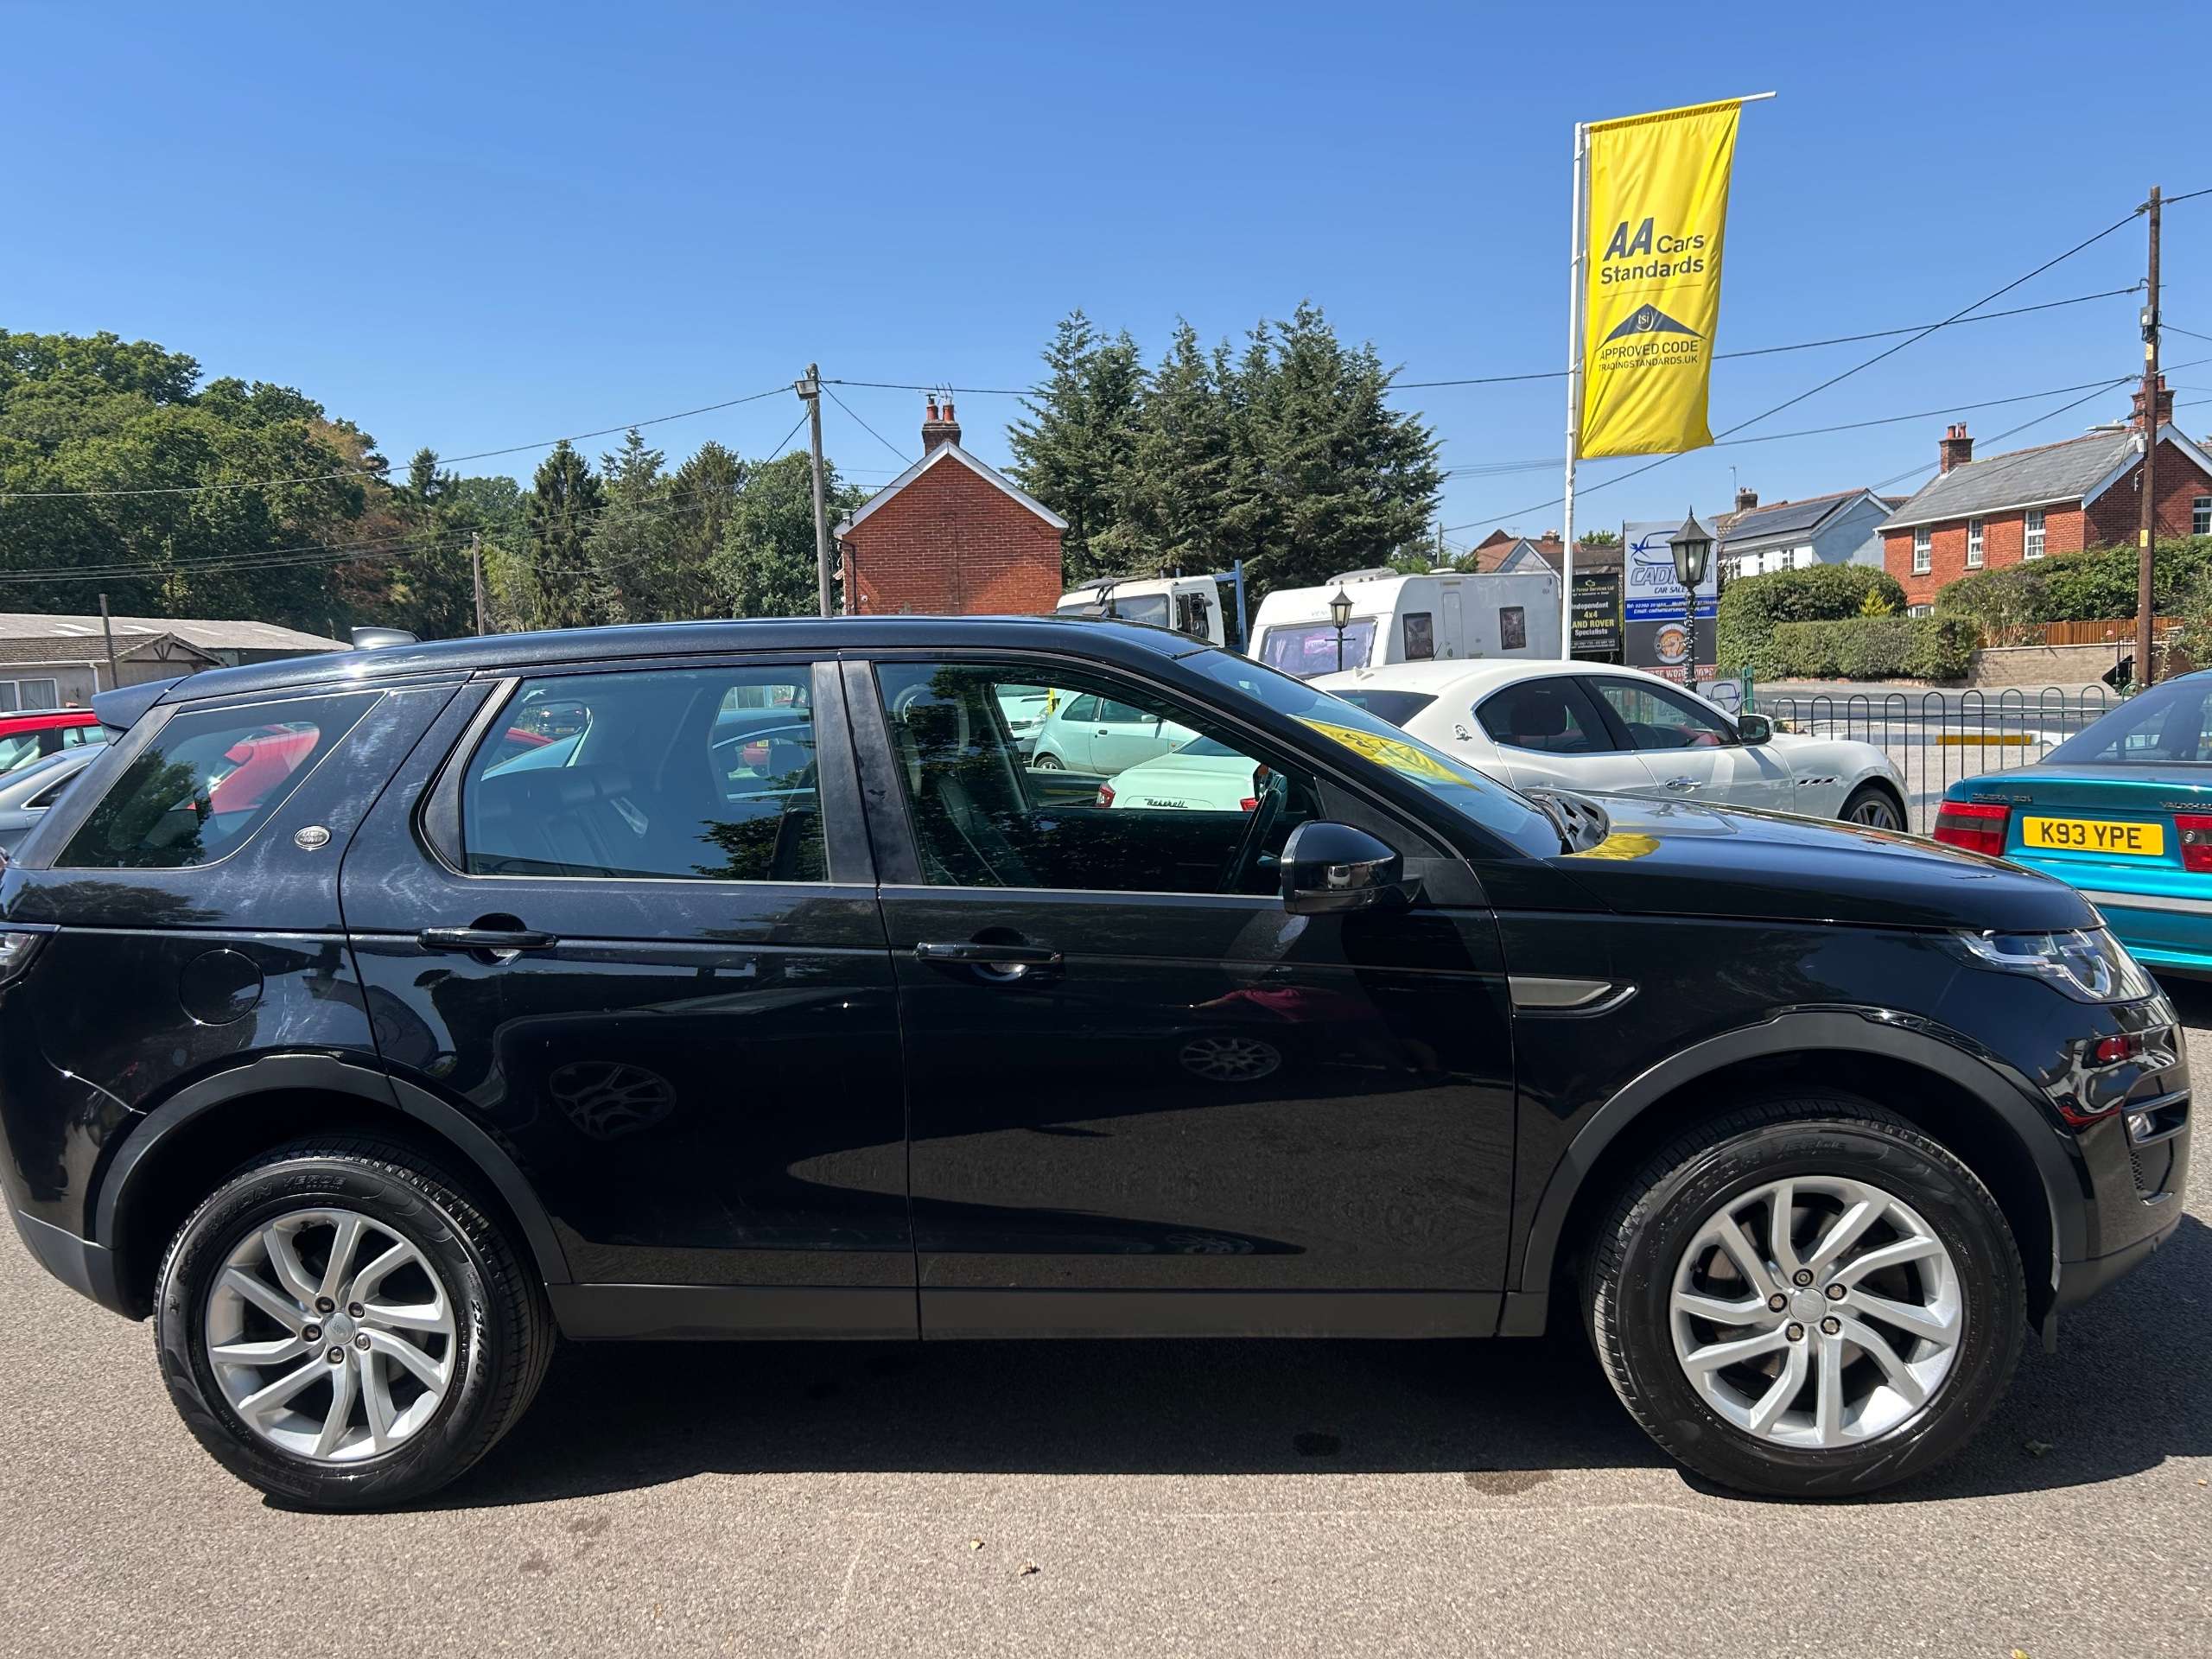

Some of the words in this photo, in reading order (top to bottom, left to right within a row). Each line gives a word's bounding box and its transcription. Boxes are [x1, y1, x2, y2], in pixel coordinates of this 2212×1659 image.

[1603, 217, 1654, 262] AA
[1656, 234, 1705, 254] Cars
[1601, 255, 1704, 285] Standards
[1599, 342, 1659, 361] APPROVED
[1662, 340, 1699, 354] CODE
[1599, 354, 1698, 372] TRADINGSTANDARDS.UK
[1571, 601, 1609, 610] Independent
[1583, 610, 1598, 619] 4x4
[1572, 620, 1588, 629] AND
[1589, 619, 1614, 627] ROVER
[1574, 628, 1608, 637] Specialists
[2041, 821, 2085, 845] K93
[2094, 824, 2142, 849] YPE
